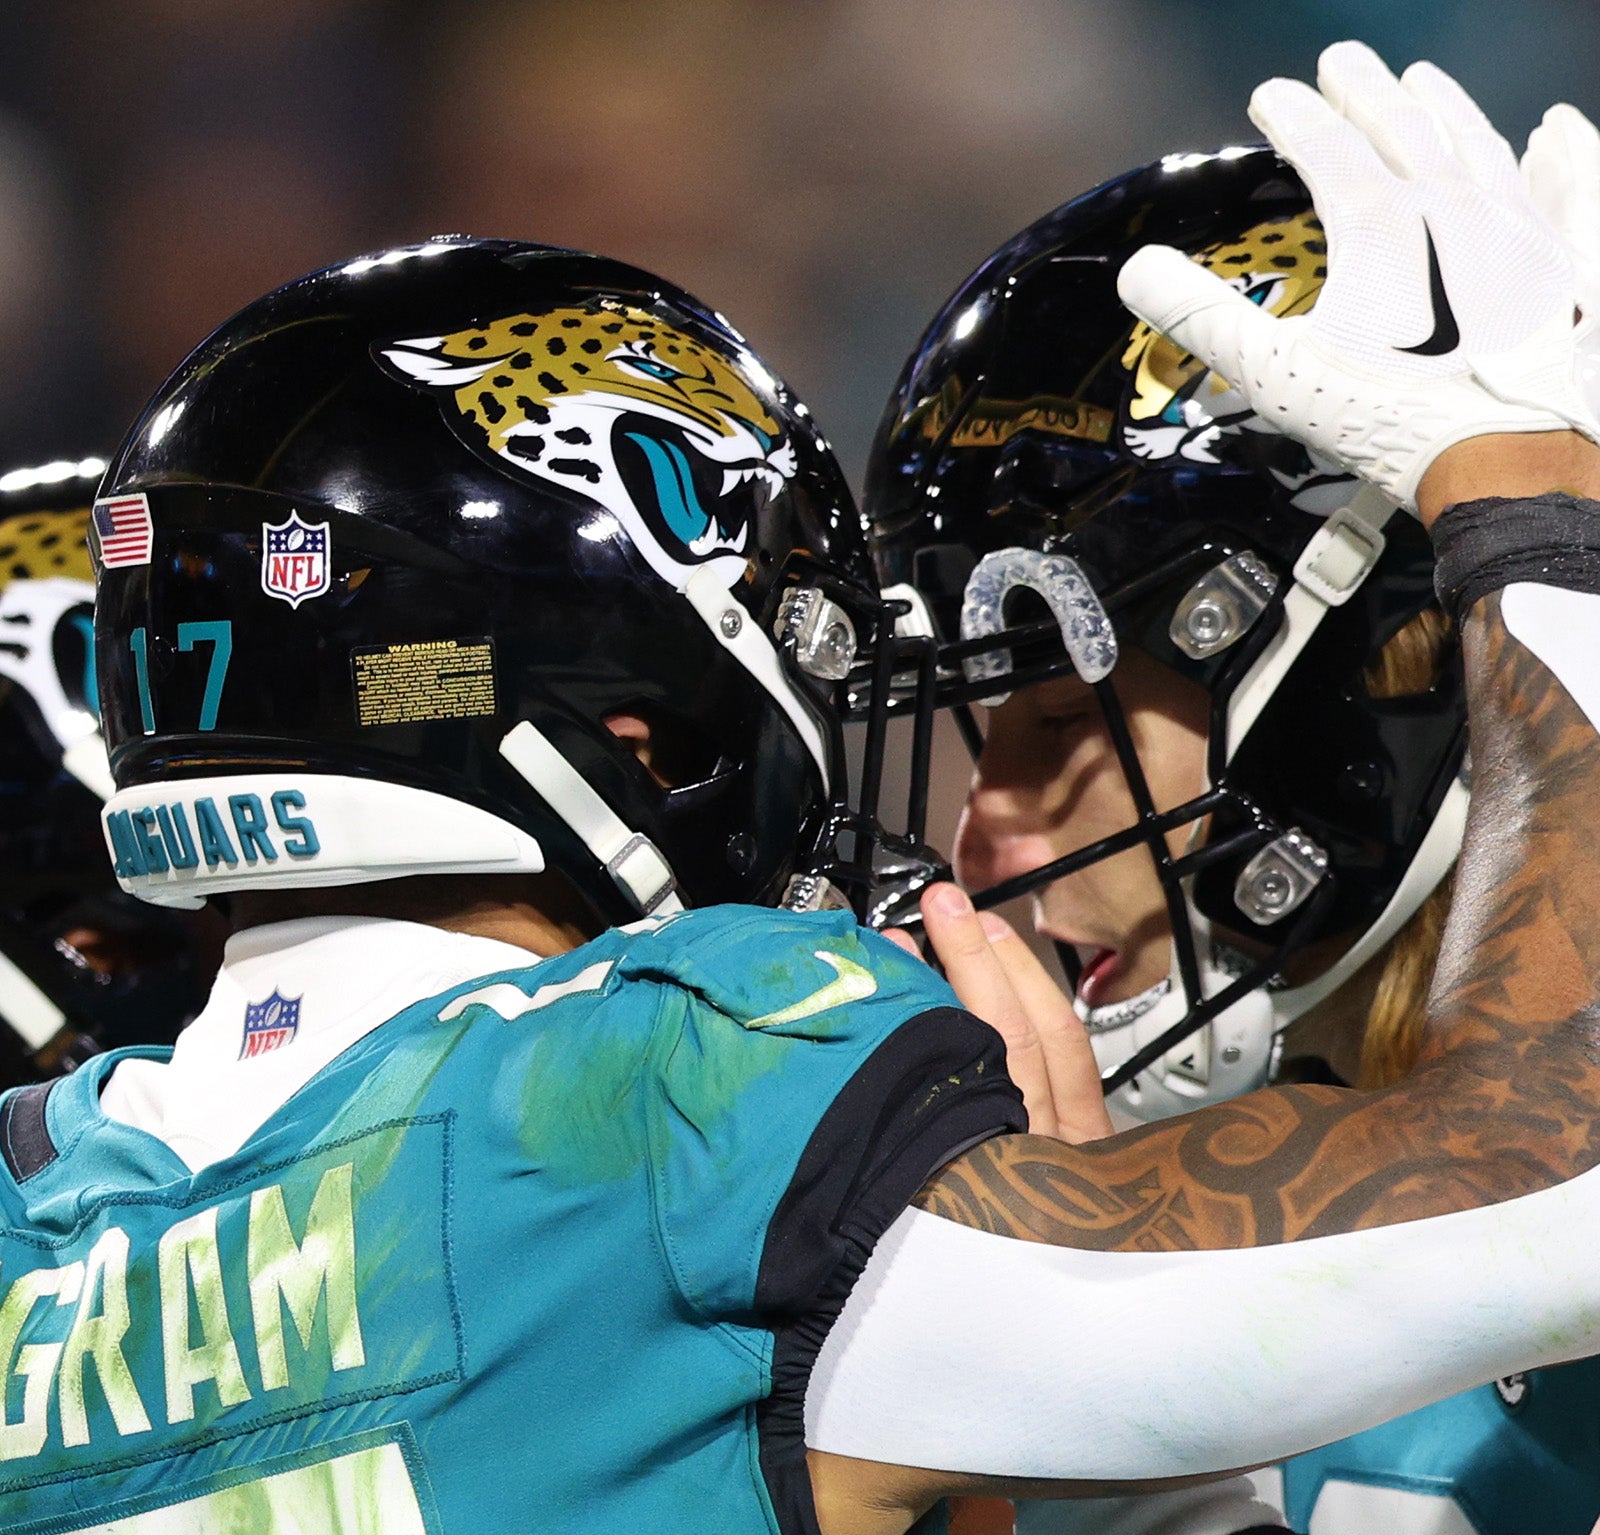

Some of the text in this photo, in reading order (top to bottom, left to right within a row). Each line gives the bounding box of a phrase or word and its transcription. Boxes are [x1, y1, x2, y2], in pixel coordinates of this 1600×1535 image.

[270, 555, 321, 592] NFL
[388, 640, 458, 653] WARNING
[130, 620, 232, 735] 17
[243, 1030, 288, 1060] NFL
